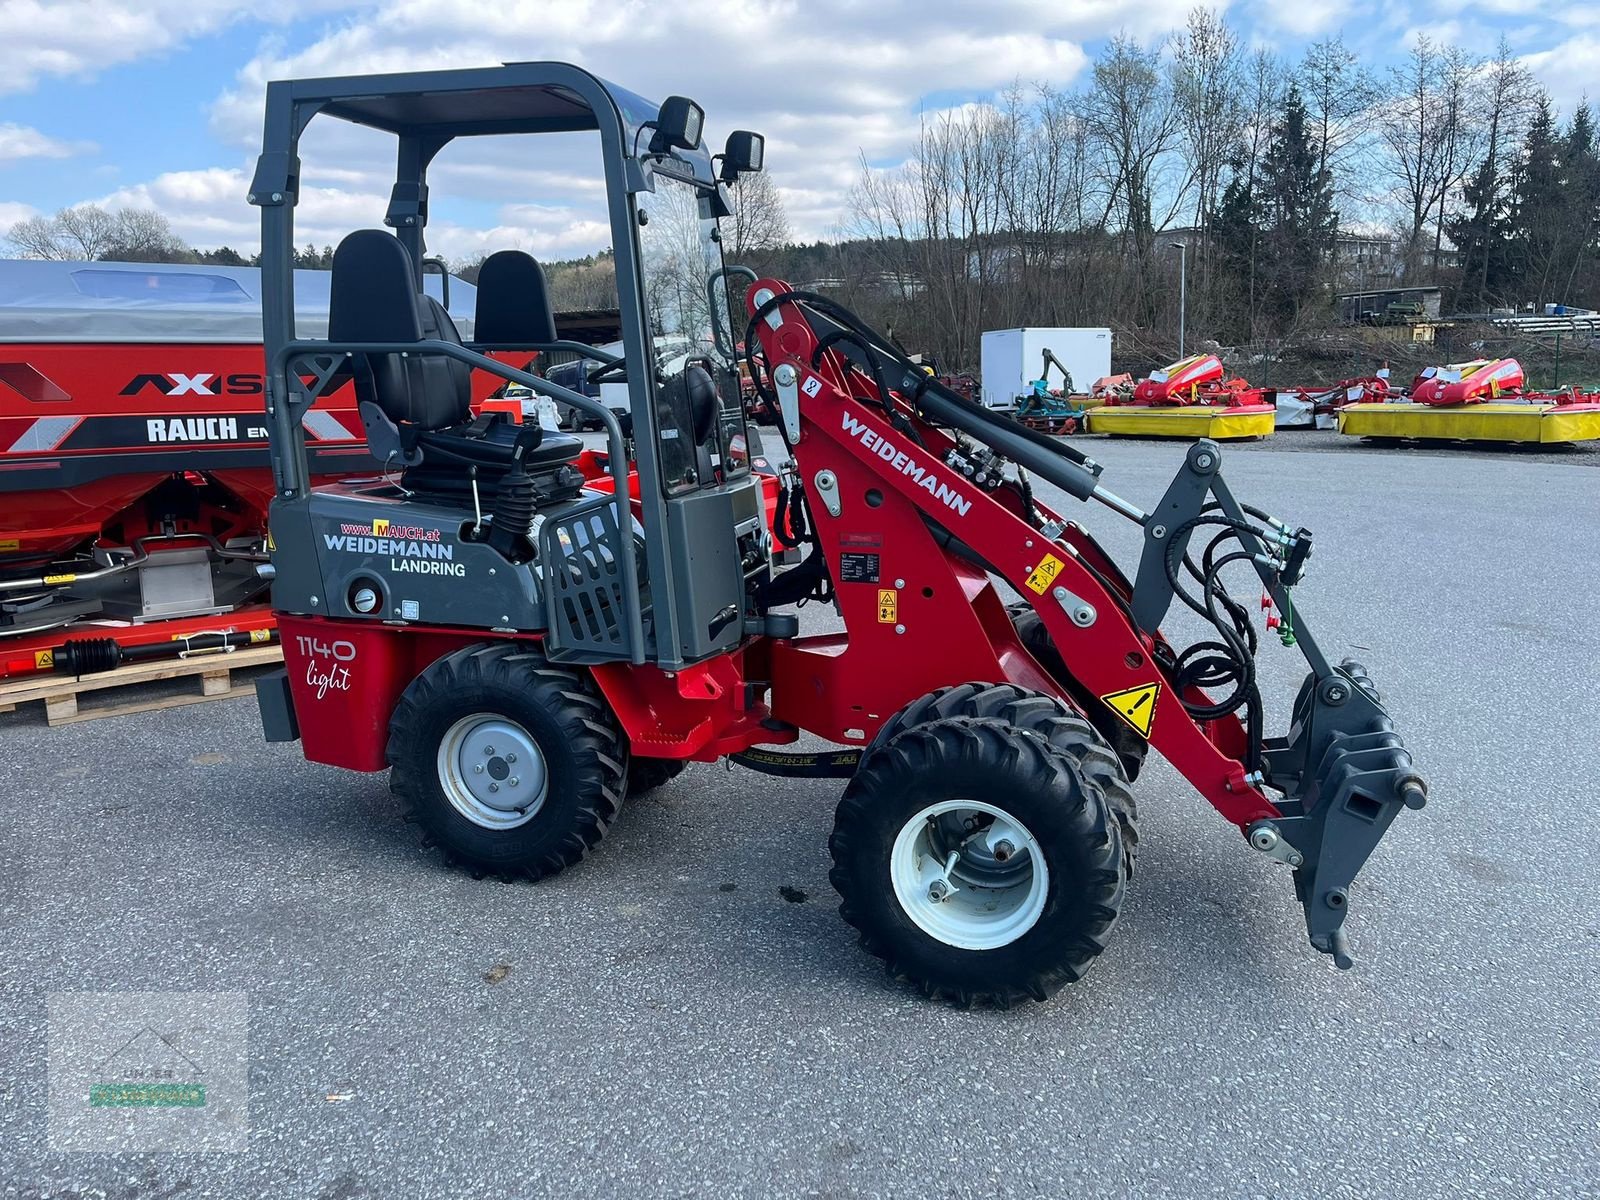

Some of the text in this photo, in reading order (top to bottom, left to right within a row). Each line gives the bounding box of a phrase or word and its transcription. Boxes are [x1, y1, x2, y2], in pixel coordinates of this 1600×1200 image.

[118, 373, 263, 396] AXIS
[146, 418, 238, 442] RAUCH
[841, 411, 972, 517] WEIDEMANN
[340, 523, 440, 542] www.MAUCH.at
[323, 534, 453, 560] WEIDEMANN
[391, 558, 466, 577] LANDRING
[296, 635, 356, 661] 1140
[306, 659, 351, 699] light
